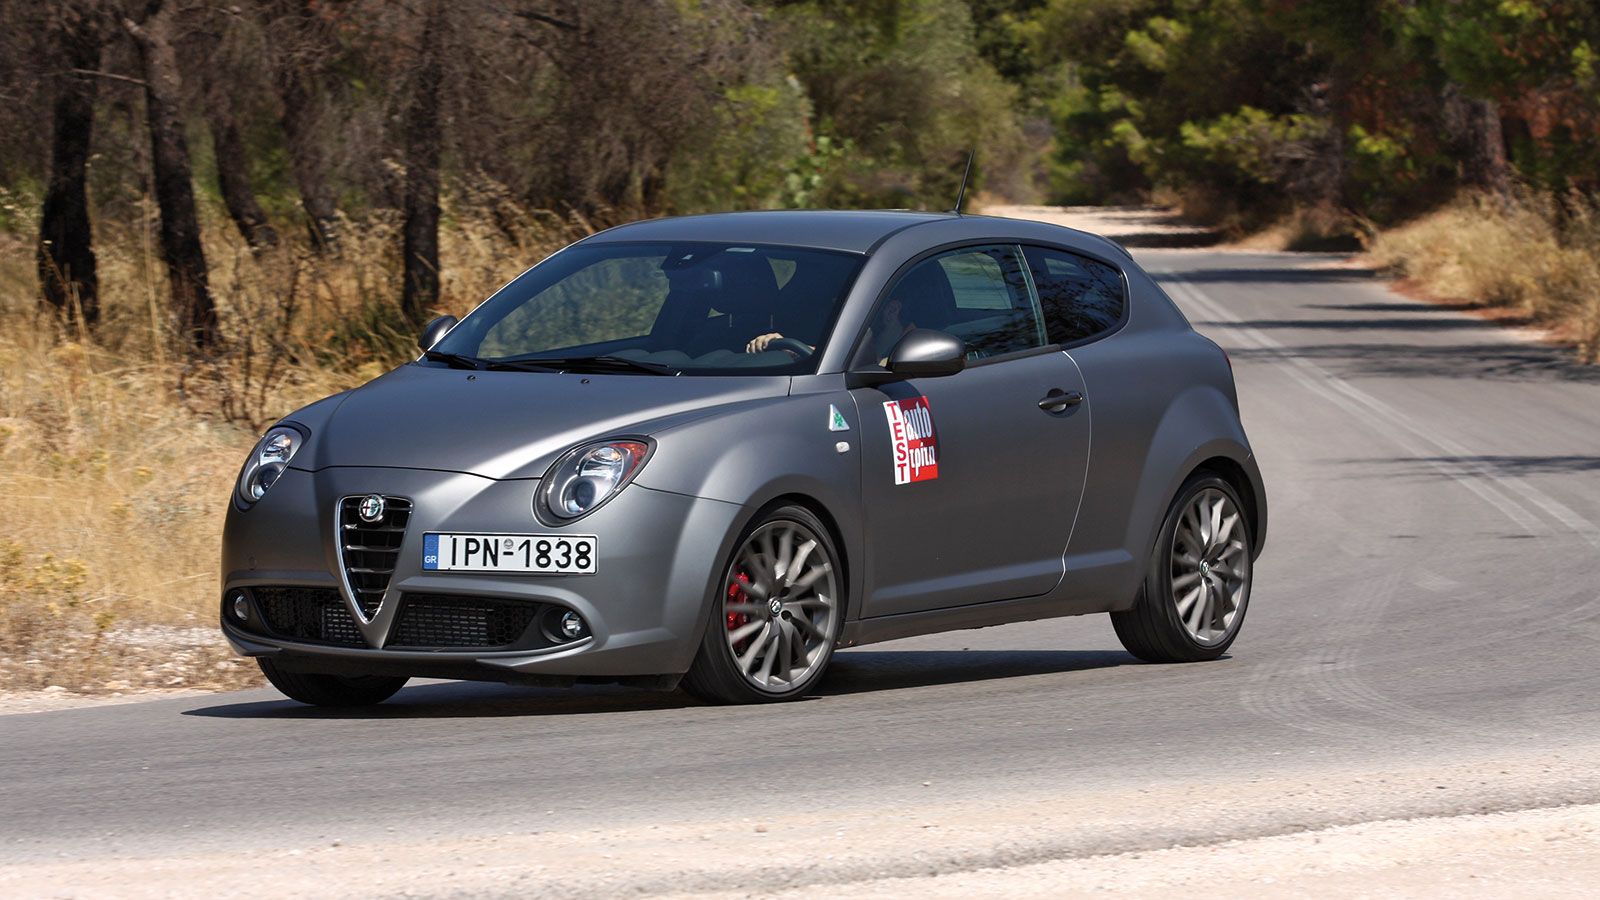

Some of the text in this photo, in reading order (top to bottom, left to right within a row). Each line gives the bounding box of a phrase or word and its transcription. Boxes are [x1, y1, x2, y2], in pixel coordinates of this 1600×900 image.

[903, 401, 932, 440] auto
[887, 402, 907, 482] TEST
[424, 555, 437, 564] GR
